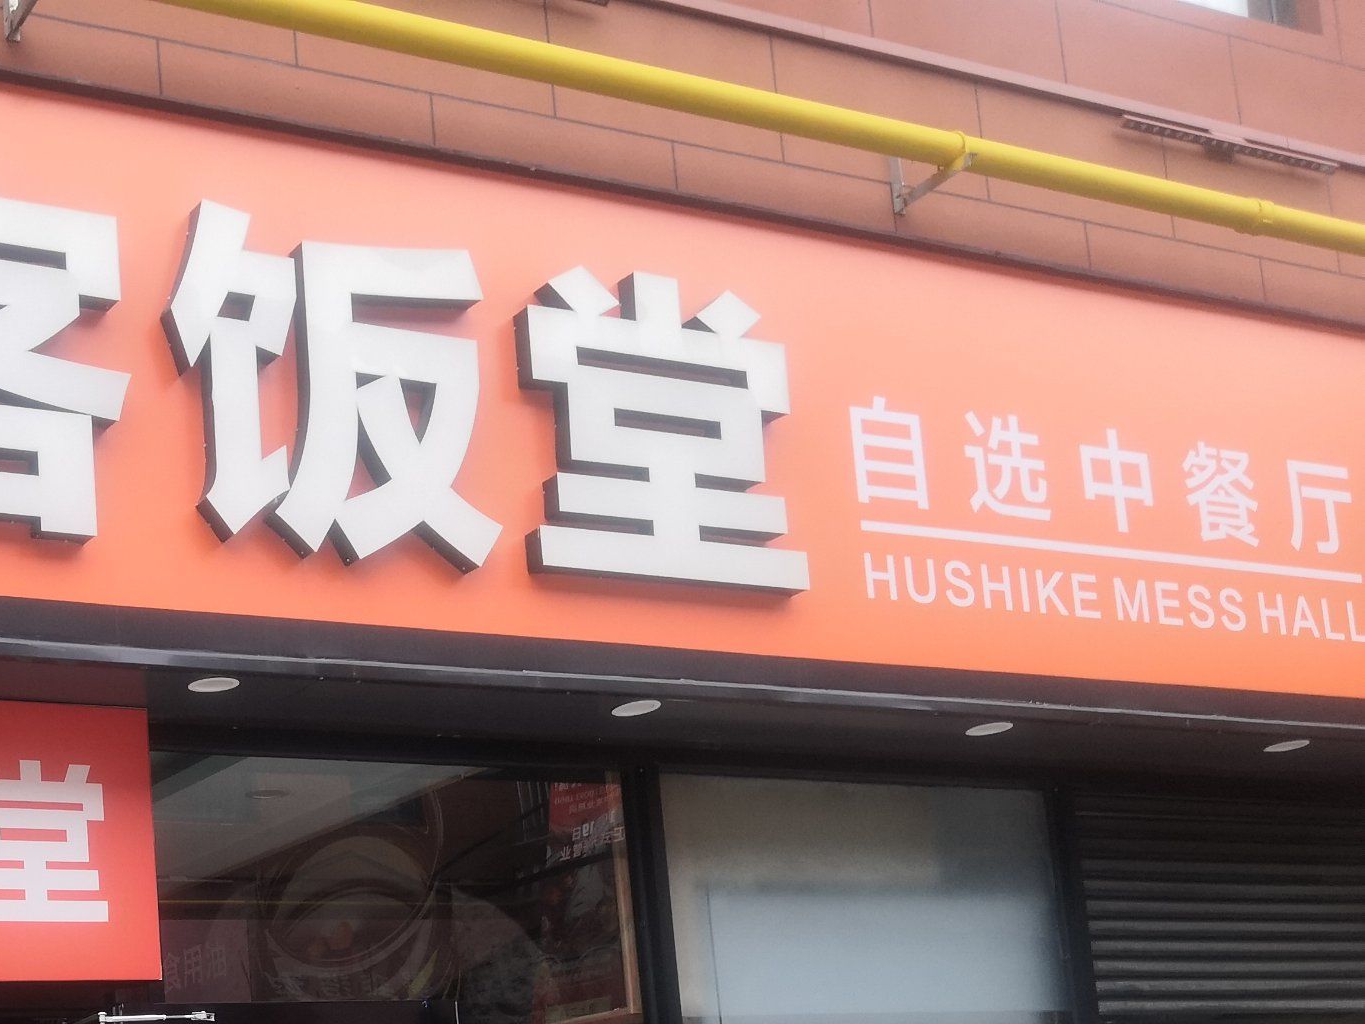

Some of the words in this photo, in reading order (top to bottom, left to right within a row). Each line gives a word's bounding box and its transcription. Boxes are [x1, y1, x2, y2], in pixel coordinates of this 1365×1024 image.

[848, 395, 1353, 554] 自选中餐厅
[863, 552, 1102, 619] HUSHIKE
[1113, 577, 1248, 632] MESS
[1257, 591, 1365, 643] HALL
